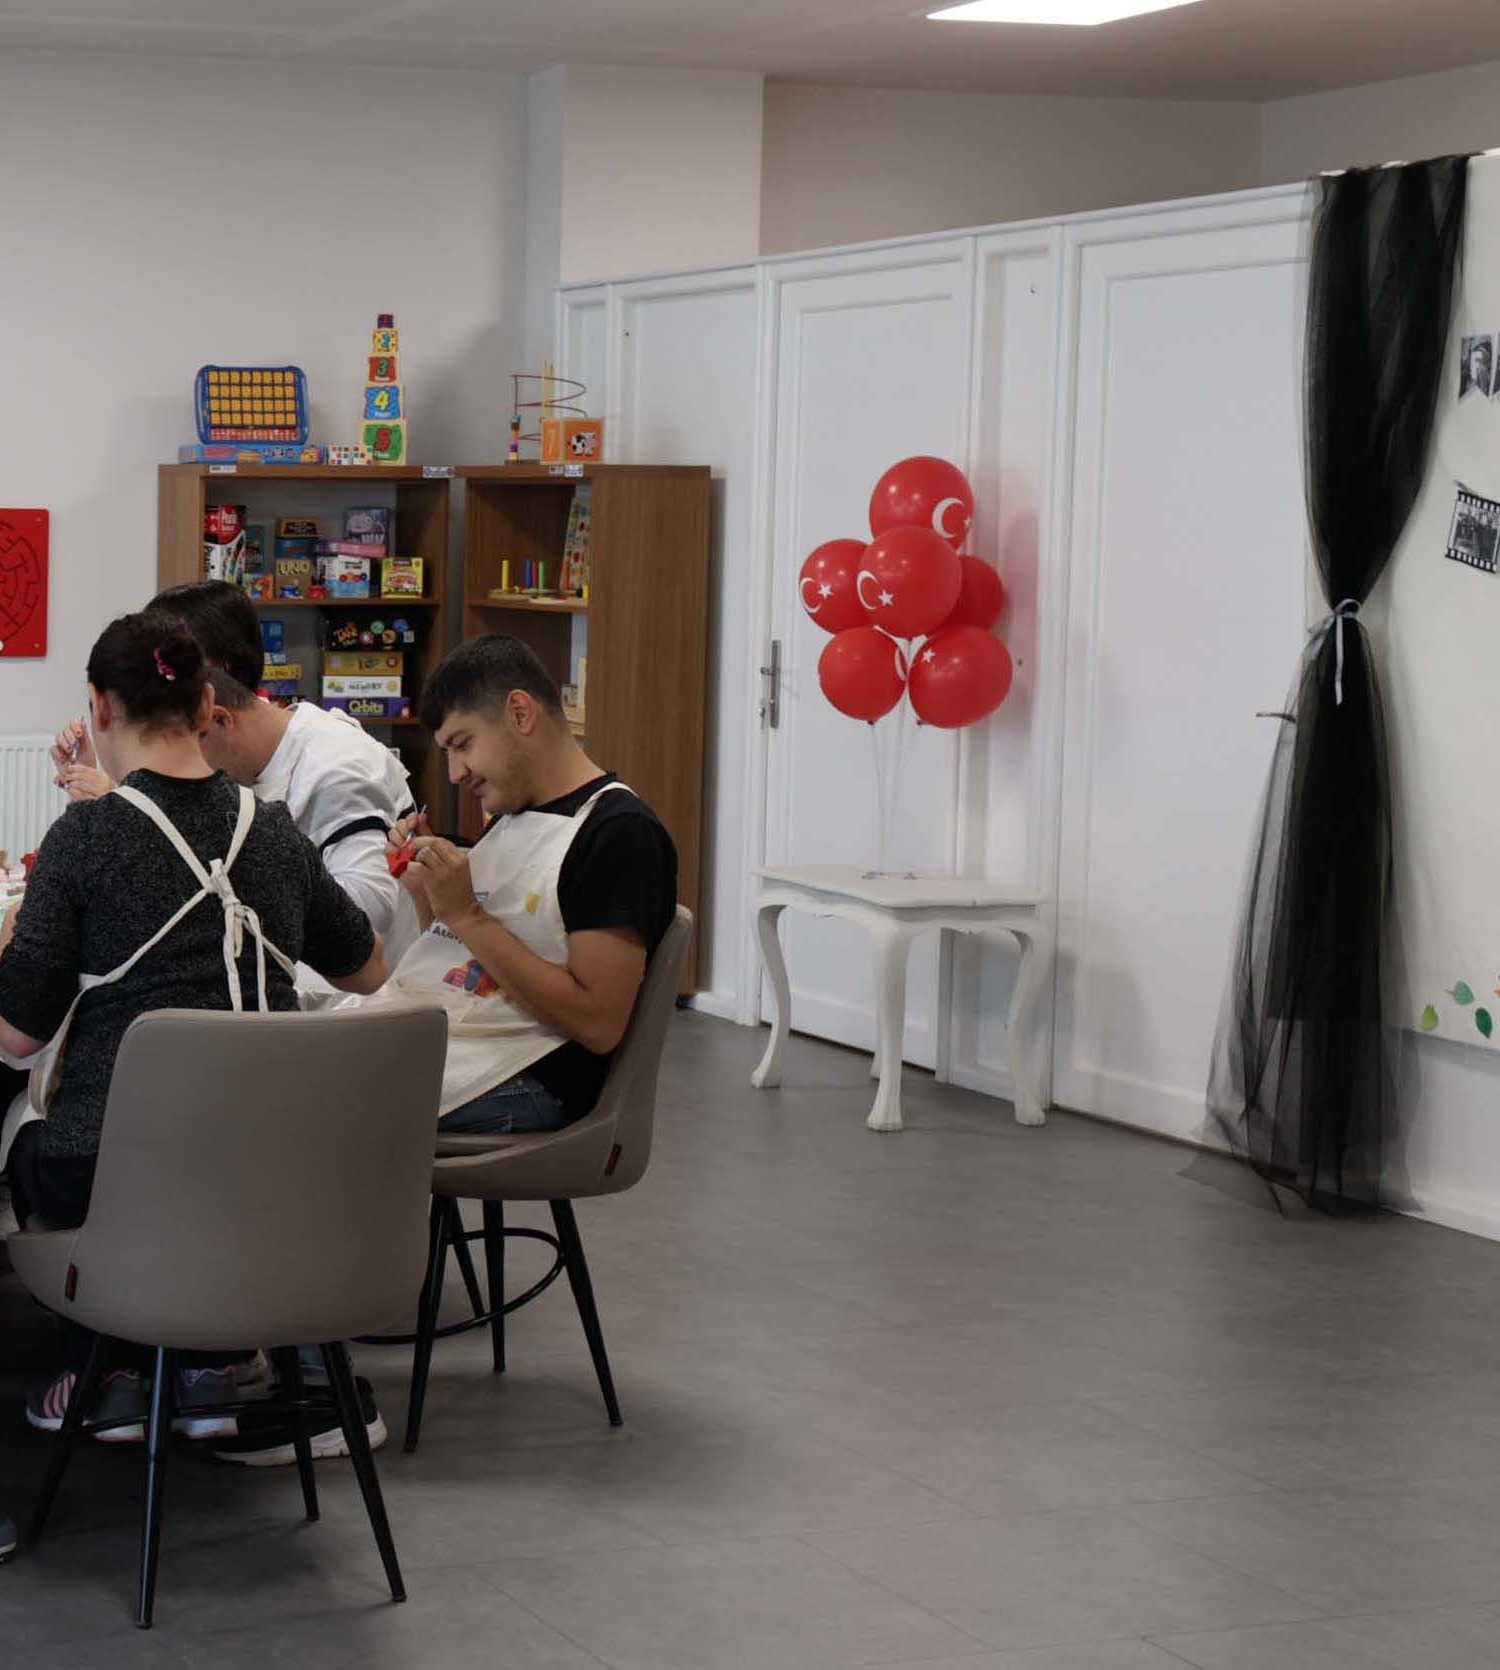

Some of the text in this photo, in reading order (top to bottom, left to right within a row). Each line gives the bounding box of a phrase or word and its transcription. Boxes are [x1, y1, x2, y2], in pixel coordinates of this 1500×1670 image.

[374, 390, 390, 411] 4
[373, 427, 393, 452] 5
[279, 560, 310, 576] UNO
